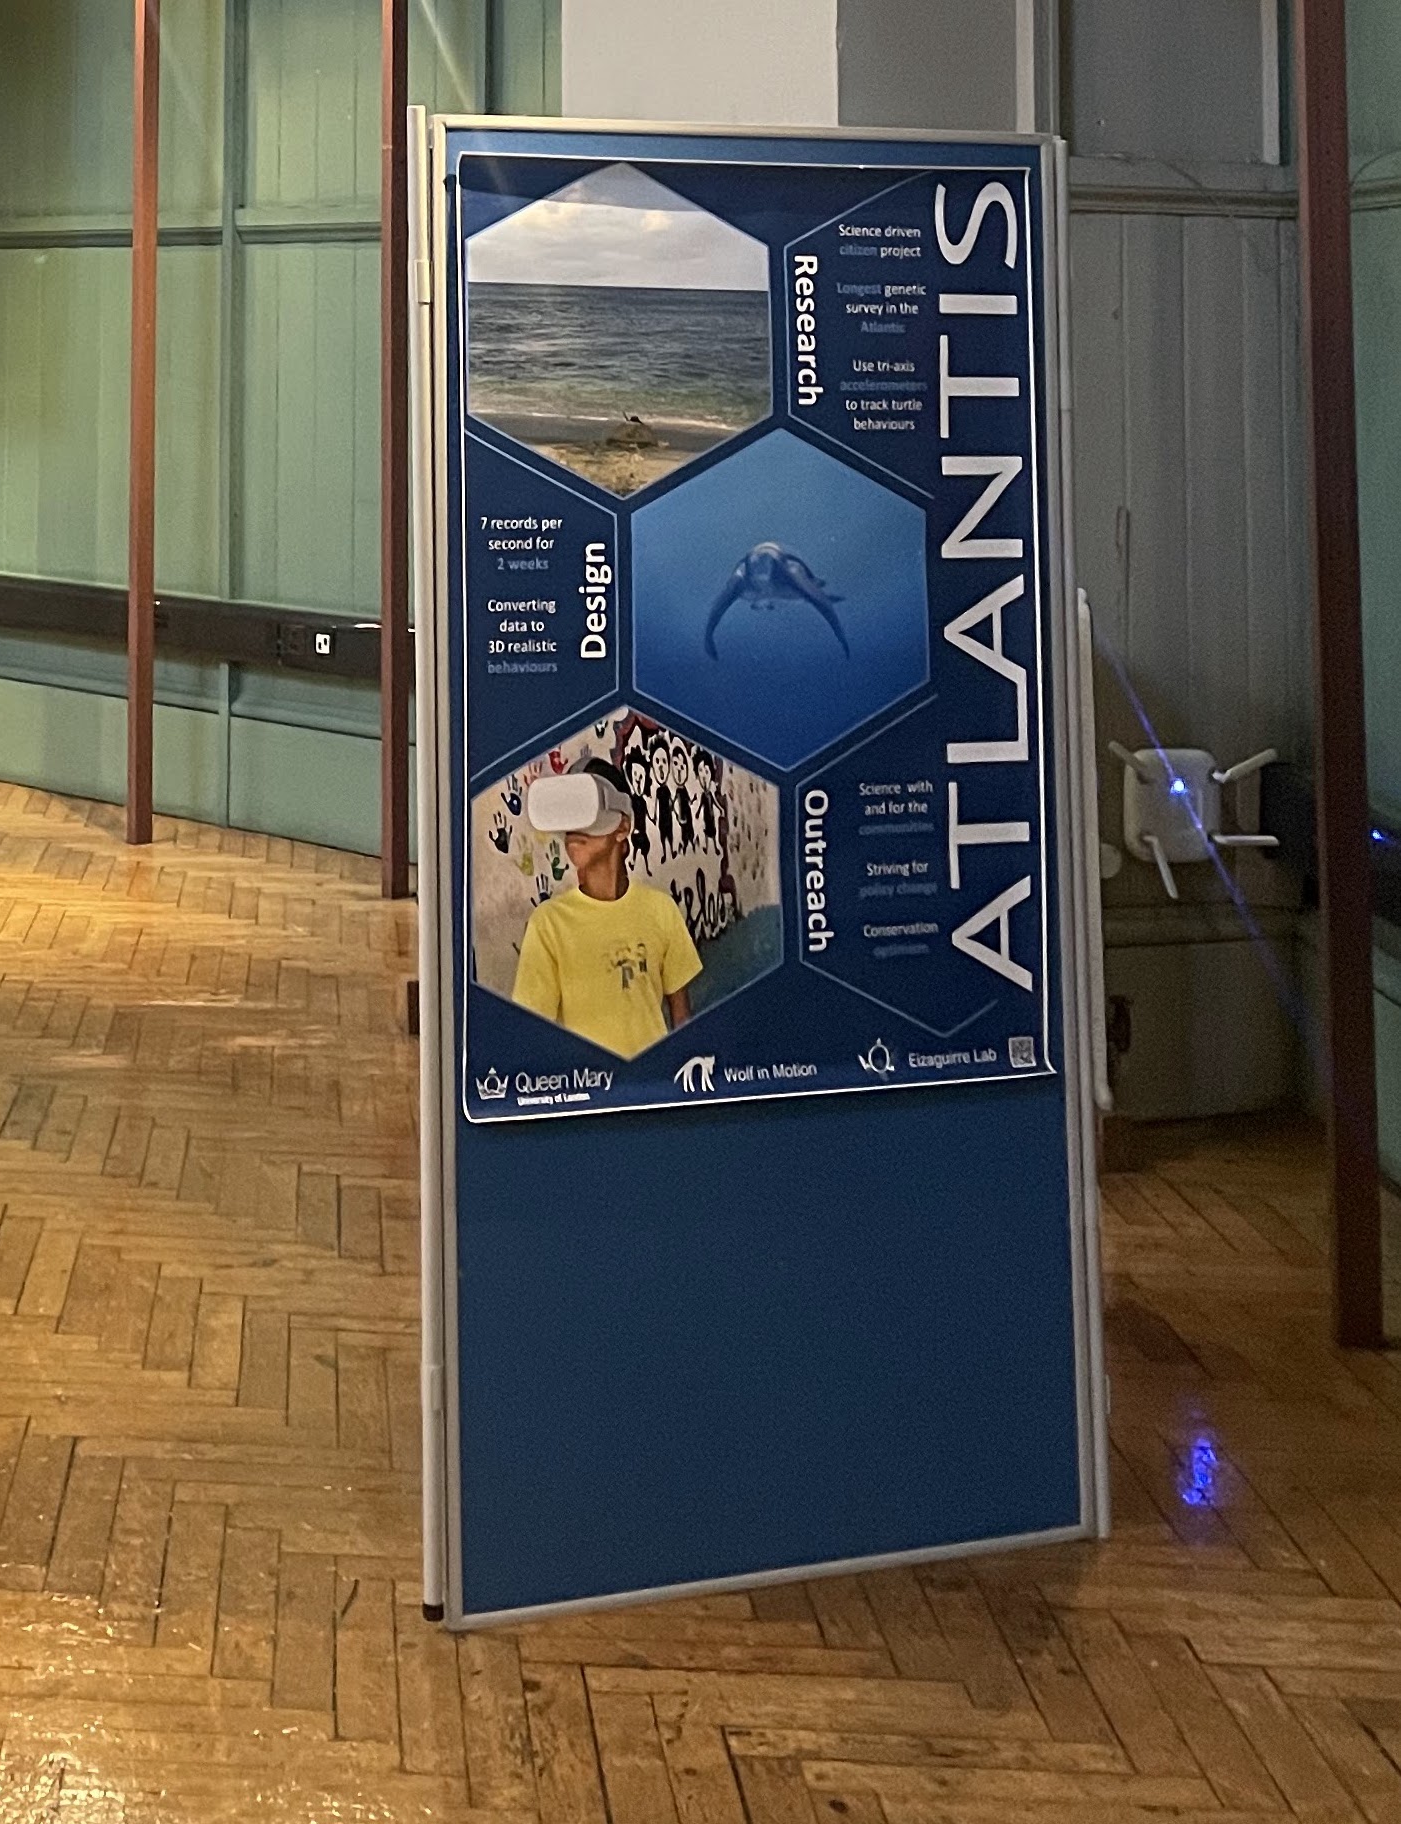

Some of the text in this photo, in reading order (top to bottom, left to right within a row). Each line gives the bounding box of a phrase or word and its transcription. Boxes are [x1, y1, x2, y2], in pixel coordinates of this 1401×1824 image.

[838, 224, 921, 238] Science driven
[880, 245, 922, 258] project
[884, 284, 926, 297] genetic
[846, 303, 919, 316] survey in the
[794, 255, 823, 405] Research
[860, 321, 905, 333] Atlantic
[853, 359, 915, 372] Use tri-axis
[845, 399, 922, 411] to track turtle
[853, 417, 915, 430] behaviours
[481, 517, 563, 532] 7 records per
[488, 536, 554, 550] second for
[497, 557, 549, 570] 2 weeks
[934, 181, 1033, 992] ATLANTIS
[487, 599, 556, 614] Converting
[578, 542, 612, 659] Design
[499, 619, 545, 632] data to
[488, 639, 557, 653] 3D realistic
[487, 661, 558, 674] behaviours
[859, 780, 933, 796] Science with
[864, 800, 928, 816] and for the
[804, 789, 835, 952] Outreach
[866, 860, 929, 877] Striving for
[863, 922, 939, 937] Conservation
[909, 1048, 997, 1067] Eizaguirre Lab
[724, 1062, 817, 1083] Wolf in Motion
[515, 1067, 614, 1094] Queen Mary
